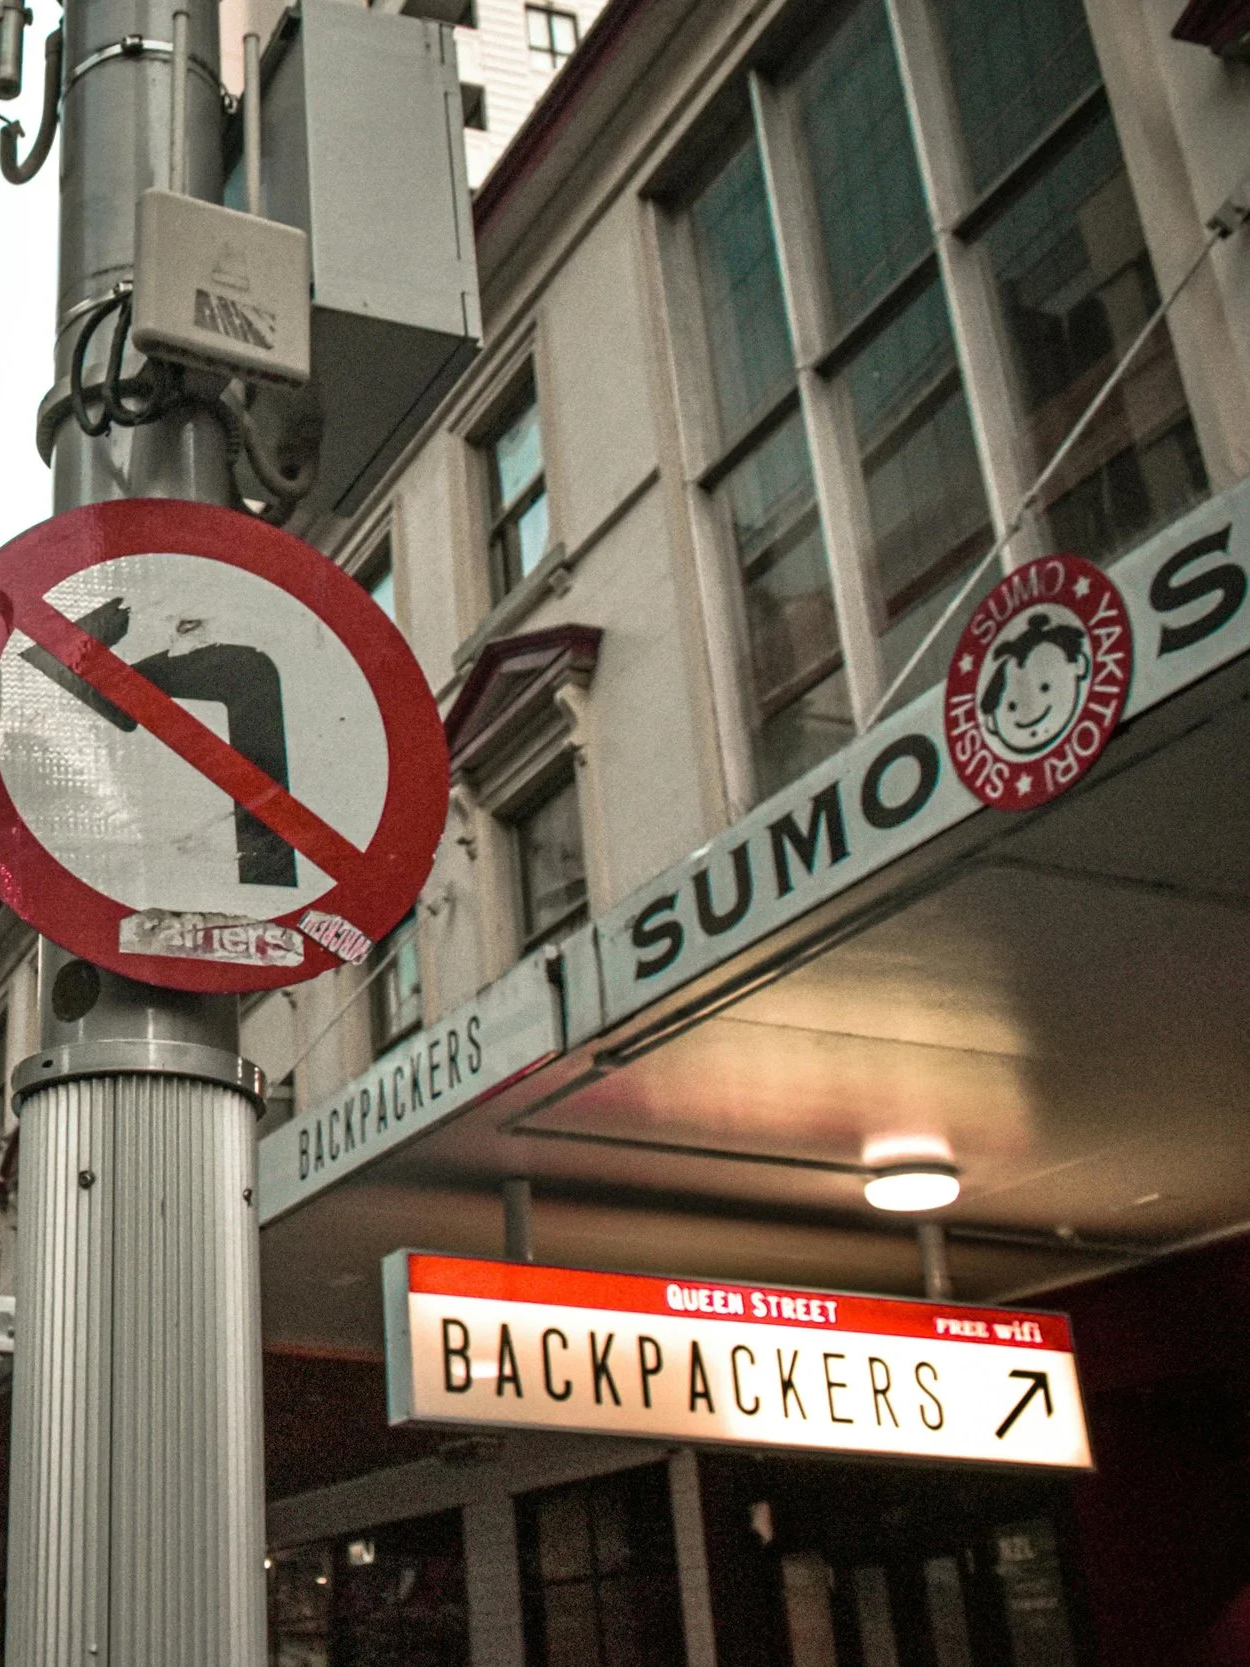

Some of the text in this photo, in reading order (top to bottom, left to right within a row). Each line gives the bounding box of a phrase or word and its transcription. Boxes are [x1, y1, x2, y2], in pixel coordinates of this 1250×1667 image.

[949, 560, 1126, 799] SUMO YAKITORI SUSHI
[632, 732, 941, 981] SUMO
[299, 1015, 482, 1181] BACKPACKERS
[665, 1283, 838, 1324] QUEEN STREET
[935, 1316, 1043, 1344] FREE wifi
[441, 1317, 944, 1431] BACKPACKERS
